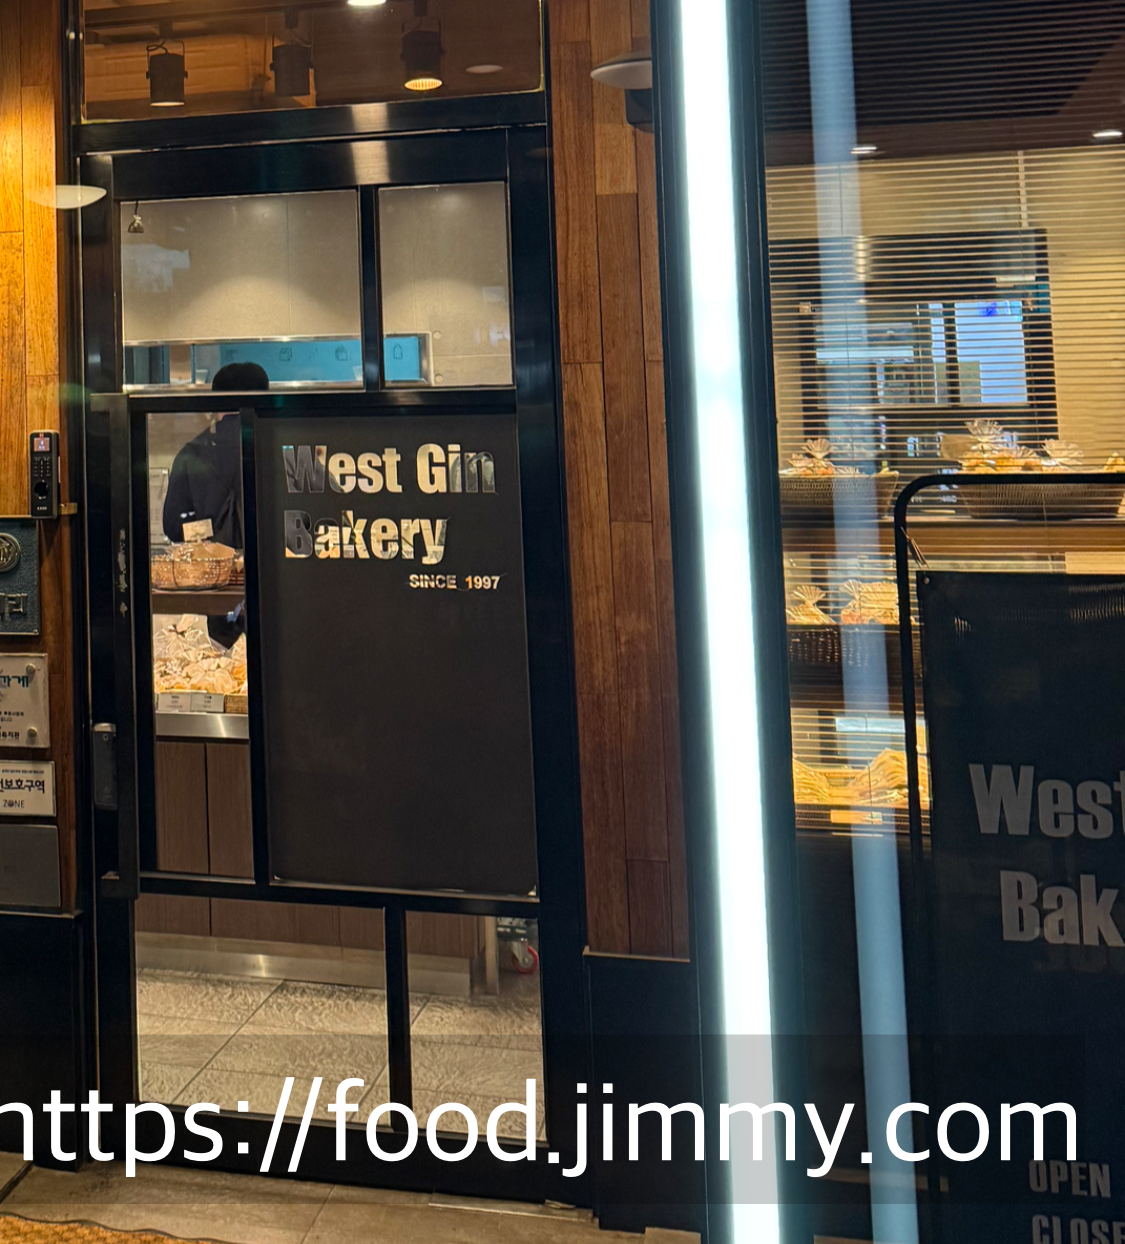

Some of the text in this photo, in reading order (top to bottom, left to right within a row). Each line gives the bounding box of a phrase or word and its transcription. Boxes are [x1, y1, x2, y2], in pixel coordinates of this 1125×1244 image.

[282, 442, 496, 494] West Gin
[283, 509, 448, 565] Bakery
[408, 573, 501, 590] SINCE 1997
[3, 798, 25, 809] ZONE
[1028, 1159, 1111, 1199] OPEN
